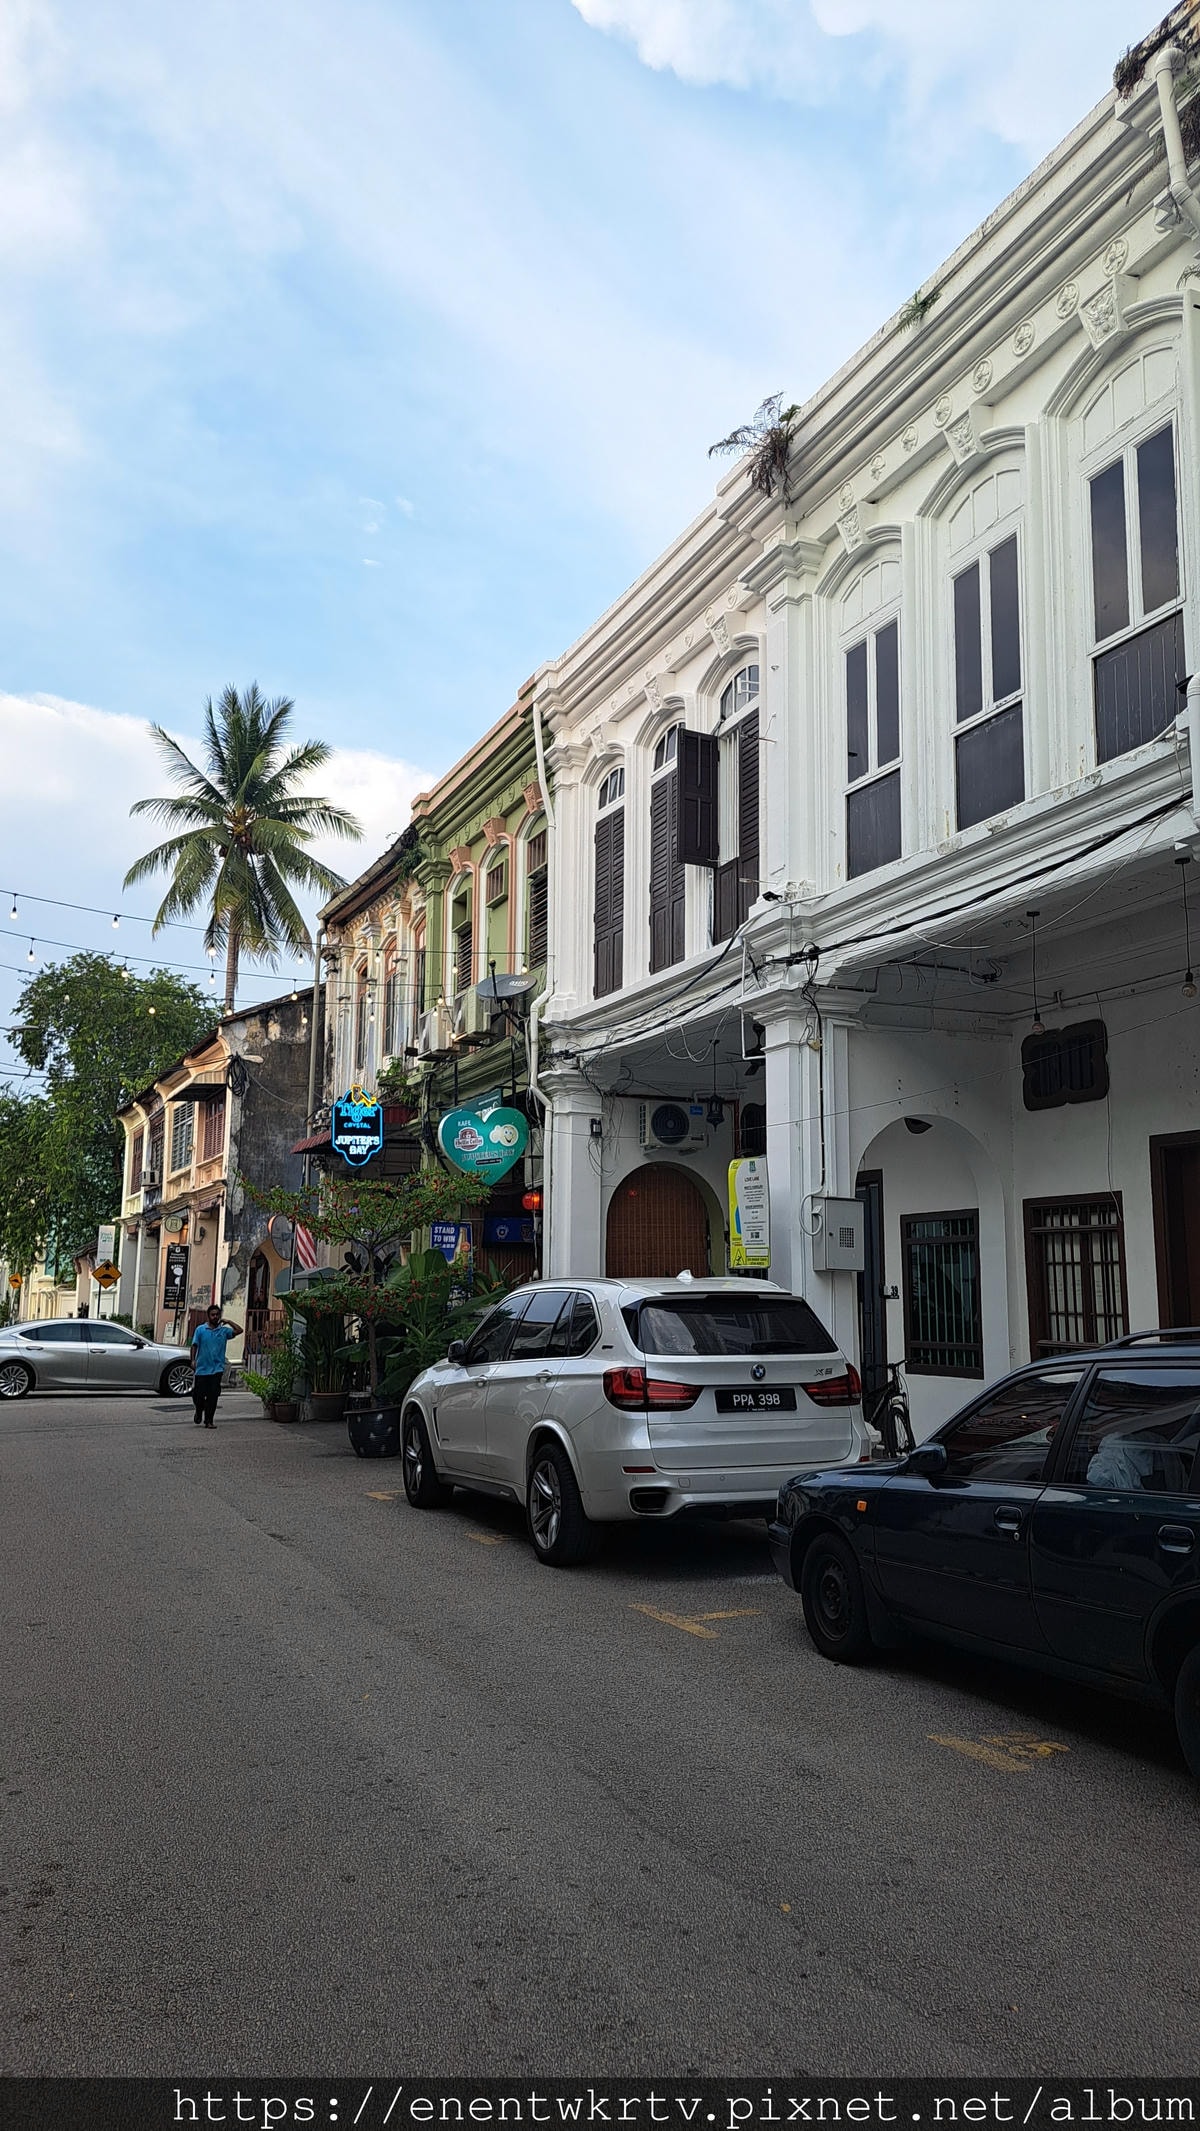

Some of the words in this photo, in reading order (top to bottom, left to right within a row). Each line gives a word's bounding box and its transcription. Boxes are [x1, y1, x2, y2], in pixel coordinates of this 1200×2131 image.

[336, 1101, 378, 1122] Tiger
[334, 1135, 380, 1146] JUPITER'S
[349, 1145, 370, 1155] BAY
[434, 1226, 455, 1234] STAND
[443, 1235, 456, 1243] WIN
[733, 1394, 755, 1406] PPA
[758, 1393, 781, 1406] 398
